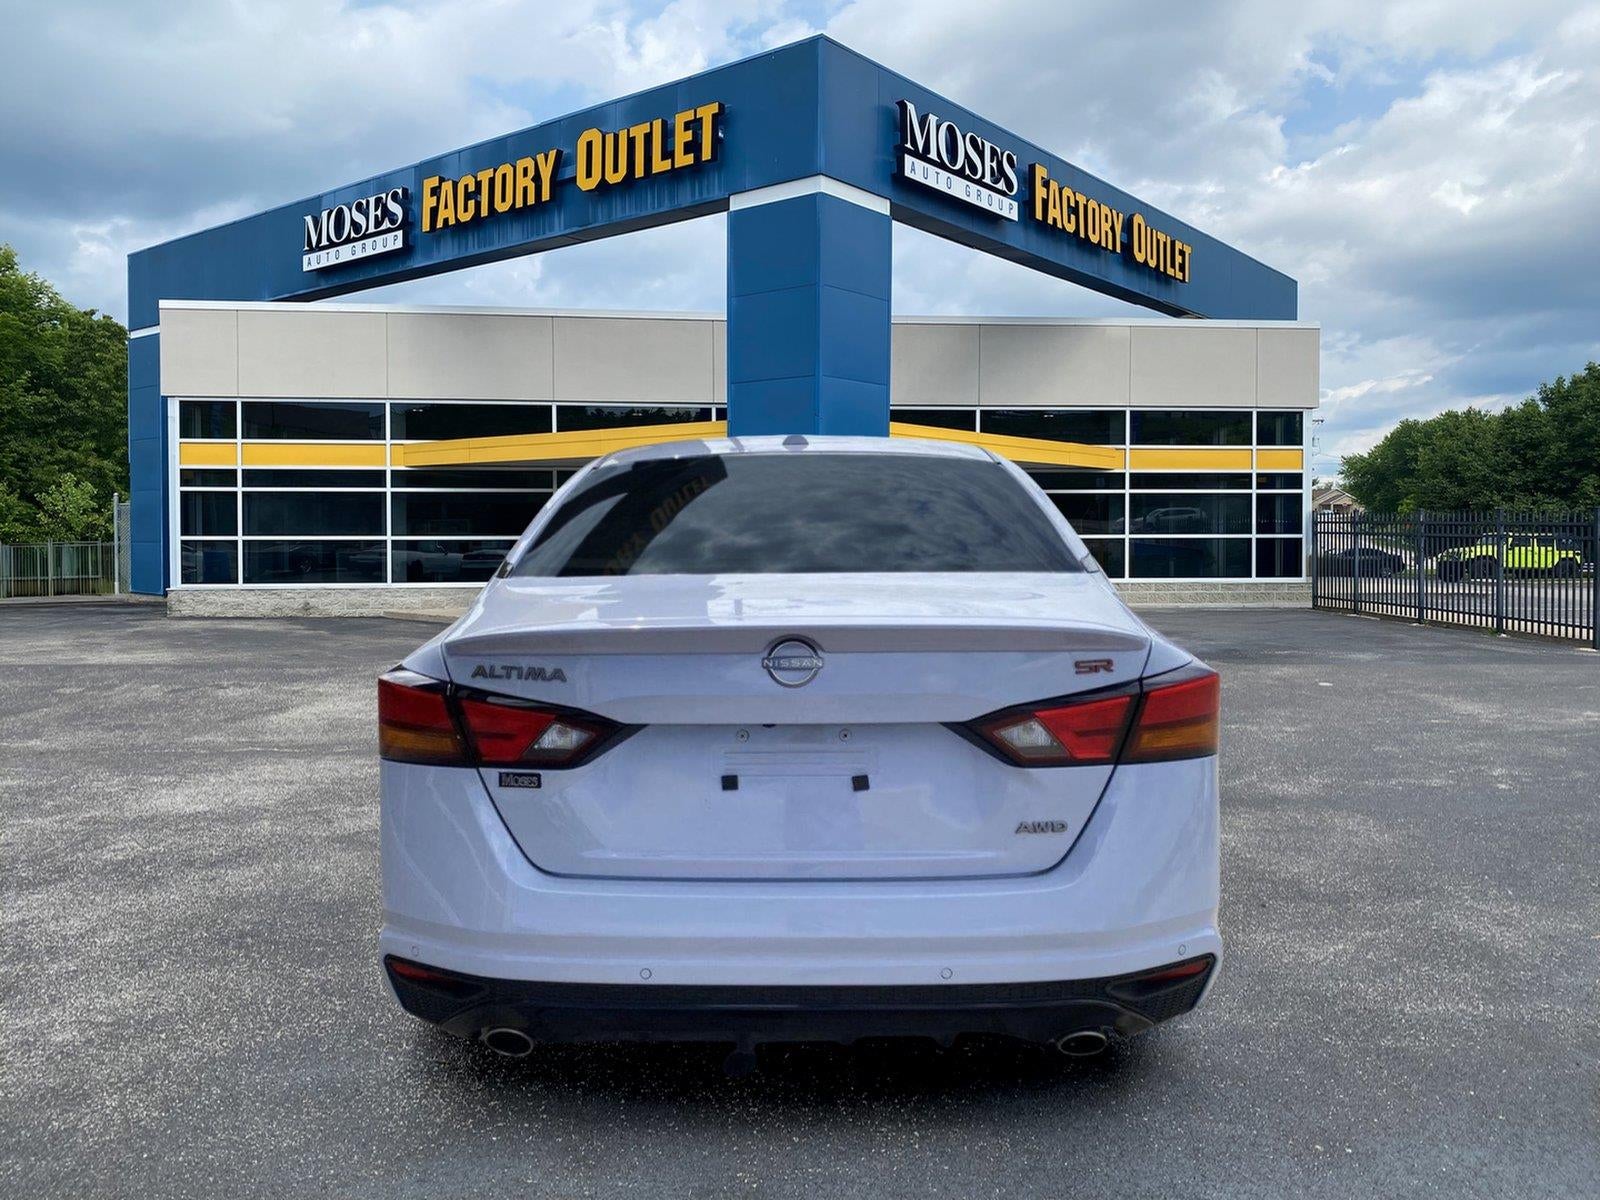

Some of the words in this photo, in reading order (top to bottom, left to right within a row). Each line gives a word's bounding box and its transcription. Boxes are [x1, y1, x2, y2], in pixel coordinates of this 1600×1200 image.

[904, 99, 1018, 196] MOSES
[422, 149, 557, 233] FACTORY
[576, 101, 720, 192] OUTLET
[910, 161, 952, 190] AUTO
[965, 184, 1014, 214] GROUP
[303, 187, 404, 251] MOSES
[1034, 163, 1124, 254] FACTORY
[1132, 212, 1192, 283] OUTLET
[306, 249, 340, 268] AUTO
[350, 234, 399, 256] GROUP
[471, 664, 567, 683] ALTIMA
[763, 658, 823, 668] NISSAN
[1074, 658, 1114, 675] SR
[501, 773, 539, 788] MOSES
[1015, 820, 1068, 834] AWD
